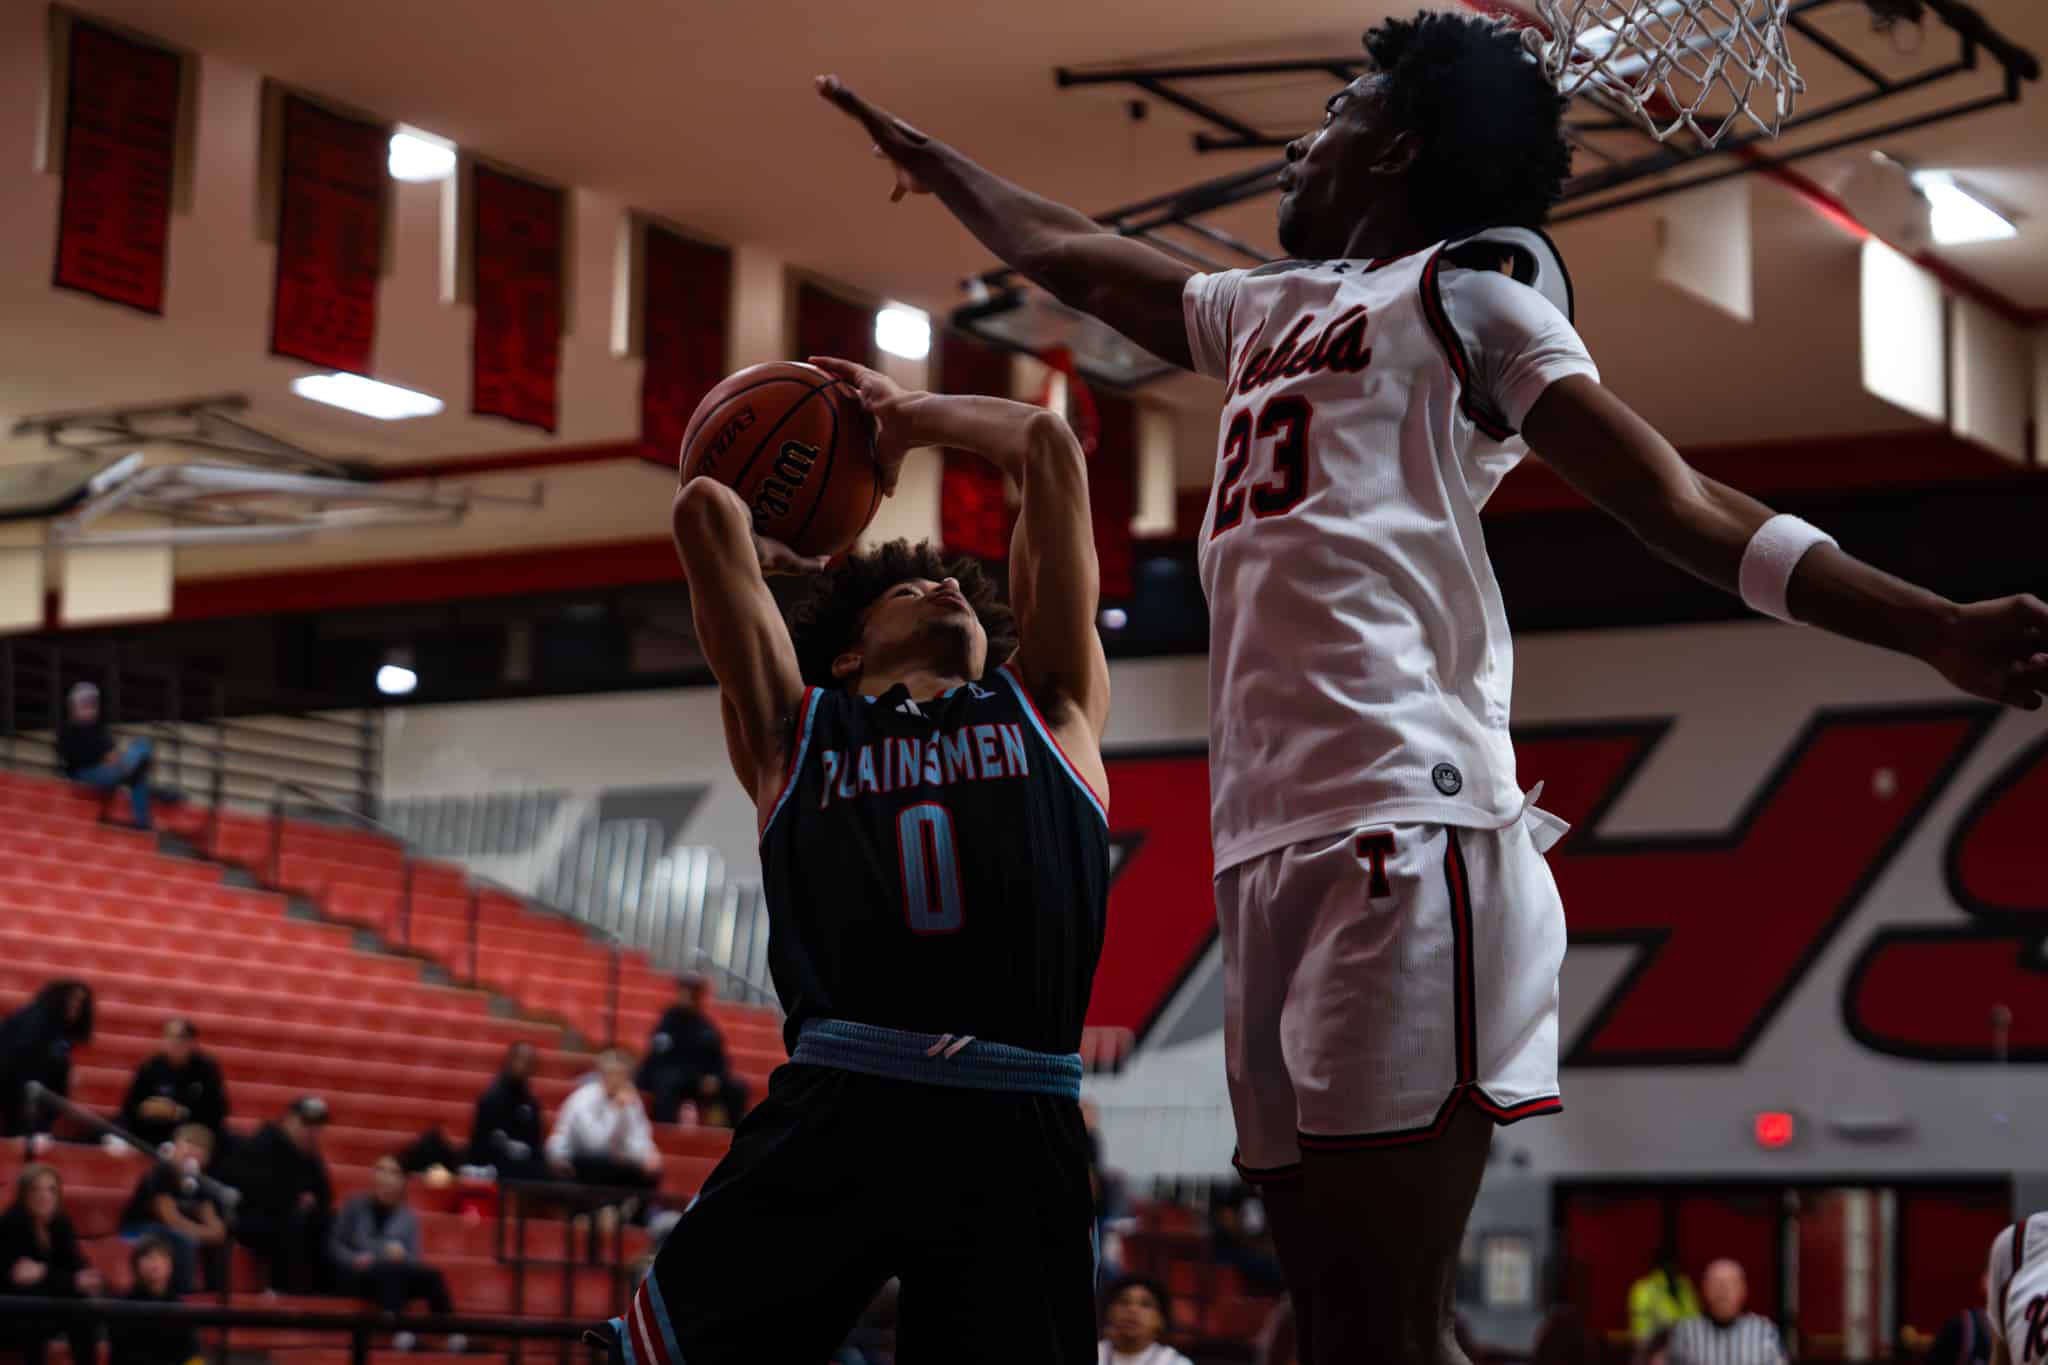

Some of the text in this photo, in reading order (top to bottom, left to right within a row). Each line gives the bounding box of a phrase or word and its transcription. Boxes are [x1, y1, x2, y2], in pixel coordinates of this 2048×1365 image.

[1225, 303, 1372, 404] ebels
[1210, 395, 1313, 540] 23
[818, 722, 1030, 812] PLAINSMEN
[896, 799, 968, 936] 0
[1357, 831, 1396, 898] T
